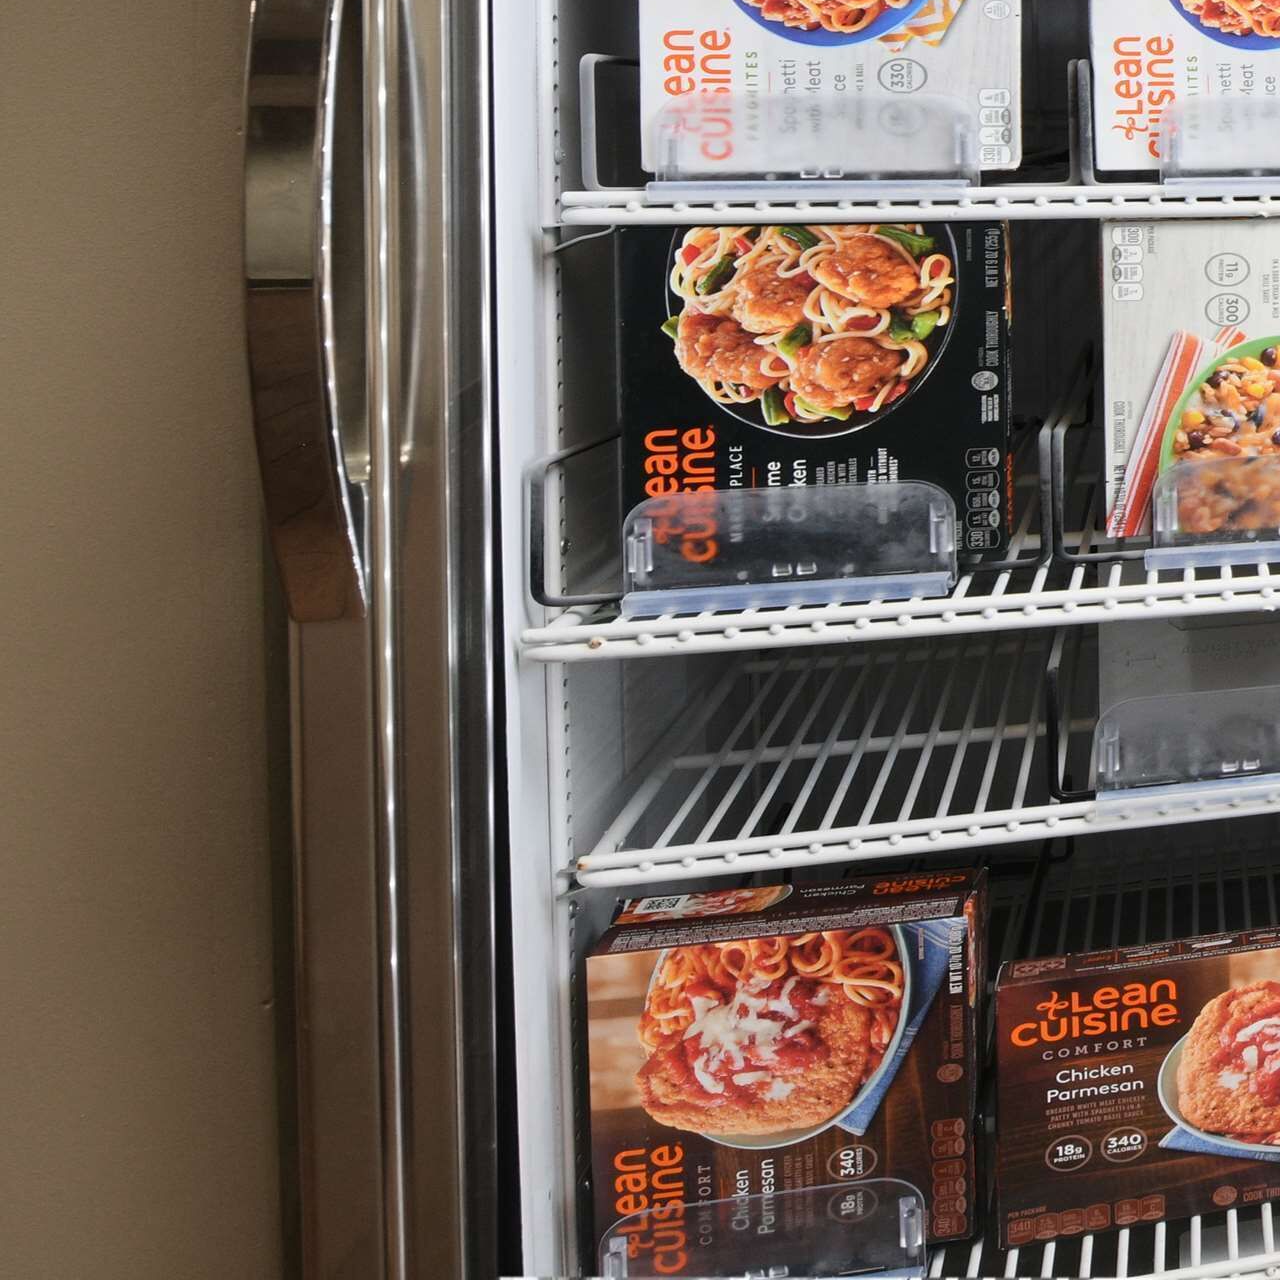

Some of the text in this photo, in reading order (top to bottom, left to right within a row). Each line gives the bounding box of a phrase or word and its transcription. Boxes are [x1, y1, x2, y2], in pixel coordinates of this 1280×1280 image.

[890, 63, 905, 89] 330
[1112, 36, 1143, 115] Lean
[983, 147, 995, 163] 330
[1127, 227, 1140, 243] 300
[985, 276, 998, 288] NET
[1224, 261, 1239, 279] 11g
[1226, 297, 1238, 323] 300
[985, 311, 999, 367] COOK THOROUGHLY
[970, 531, 983, 547] 330
[1071, 979, 1177, 1013] Lean
[1010, 1003, 1179, 1047] cuisine
[1042, 1037, 1148, 1061] COMFORT
[1055, 1063, 1134, 1084] Chicken
[1046, 1079, 1145, 1103] Parmesan
[1055, 1144, 1083, 1157] 18g
[1106, 1144, 1143, 1154] CALORIES
[1107, 1133, 1142, 1148] 340
[840, 1150, 856, 1176] 340
[856, 1147, 864, 1175] CALORIES
[1053, 1152, 1086, 1163] PROTEIN
[614, 1148, 650, 1234] Lean
[731, 1169, 750, 1230] Chicken
[757, 1158, 776, 1234] Parmesan
[651, 1144, 688, 1274] cuisine
[841, 1194, 858, 1216] 18g
